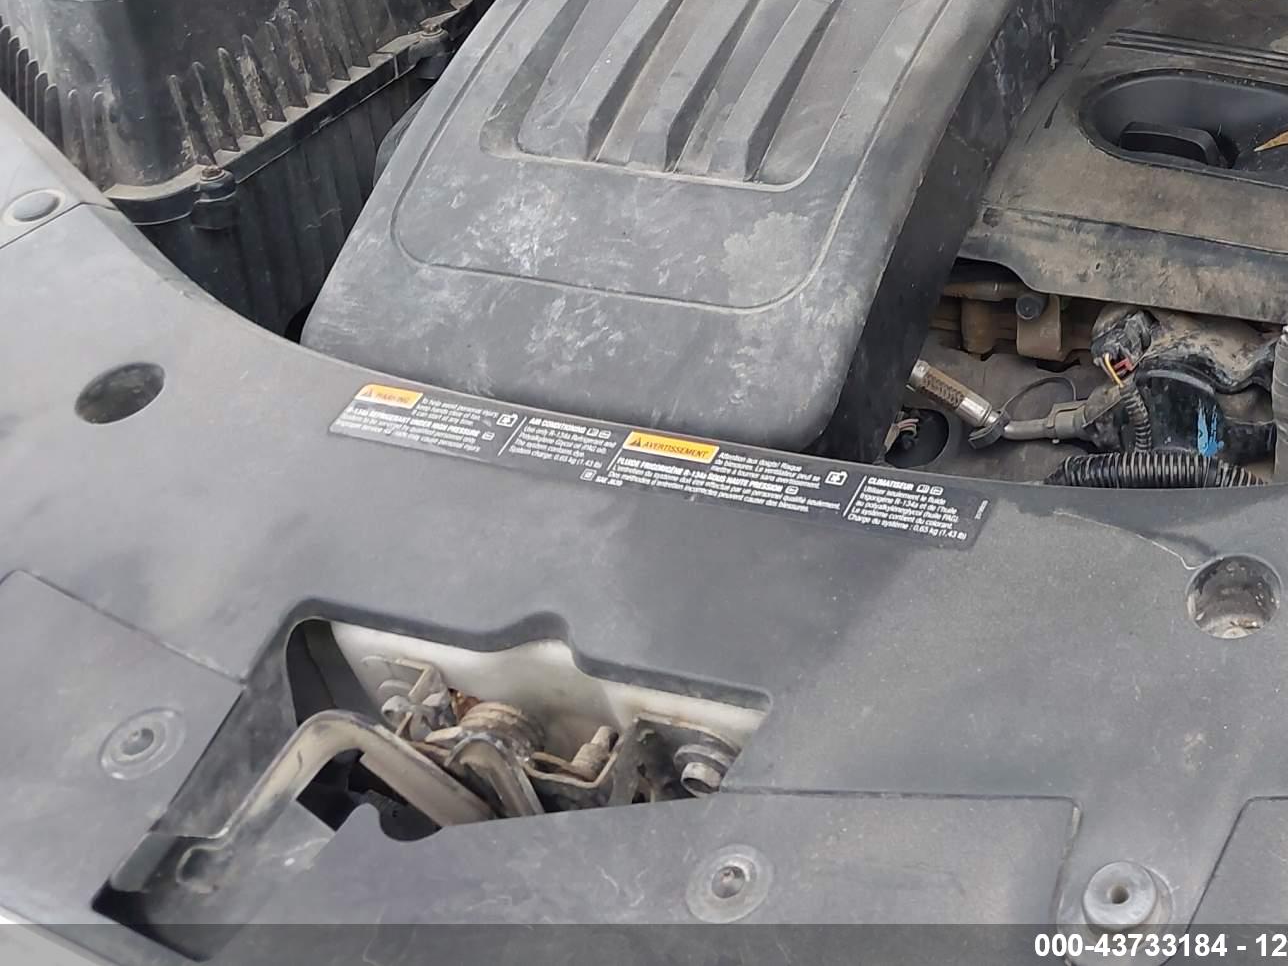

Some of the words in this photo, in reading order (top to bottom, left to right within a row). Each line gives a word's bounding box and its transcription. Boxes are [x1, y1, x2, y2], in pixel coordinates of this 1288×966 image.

[430, 421, 449, 432] HIGH
[447, 425, 481, 438] PRESSURE
[529, 417, 542, 425] AIR
[541, 419, 587, 434] CONDITIONING
[548, 429, 572, 440] R-134a
[525, 441, 548, 451] system
[642, 440, 709, 458] AVERTISSEMENT
[717, 451, 747, 463] Attention
[780, 462, 802, 472] Risque
[617, 456, 641, 467] FLUIDE
[683, 468, 708, 480] R-134a
[707, 472, 727, 483] SOUS
[725, 475, 750, 487] HAUTE
[749, 479, 783, 493] PRESSION
[867, 477, 914, 491] CLIMATISEUR
[863, 485, 887, 495] Utiliser
[886, 489, 920, 502] seulement
[927, 495, 946, 505] fluide
[893, 497, 919, 509] R-134a
[847, 513, 872, 524] Charge
